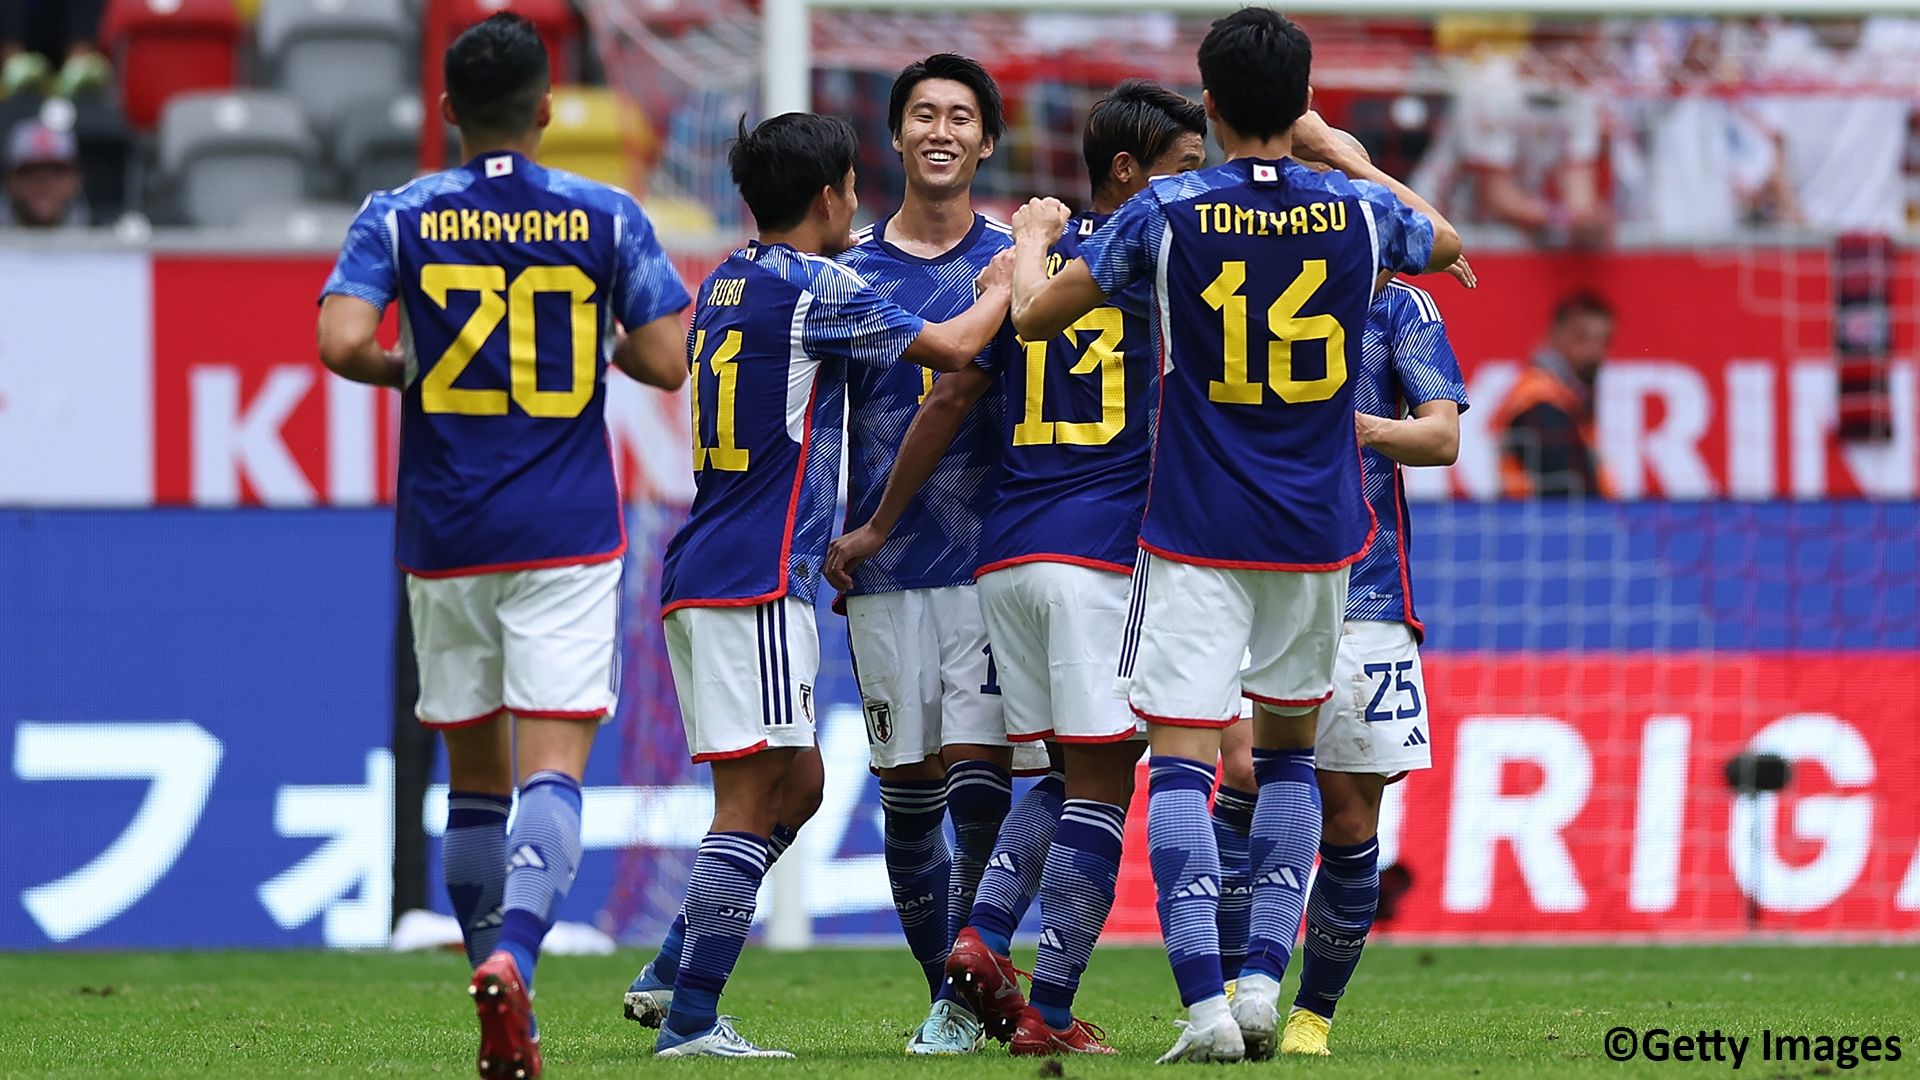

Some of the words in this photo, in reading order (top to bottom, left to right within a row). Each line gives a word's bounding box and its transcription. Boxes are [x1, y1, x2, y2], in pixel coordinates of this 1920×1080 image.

[420, 208, 591, 243] NAKAYAMA
[1194, 201, 1347, 235] TOMIYASU
[419, 262, 599, 418] 20
[707, 278, 747, 306] KUBO
[1199, 259, 1348, 405] 16
[691, 329, 750, 471] 11
[1012, 307, 1126, 446] 13
[1363, 660, 1422, 722] 25
